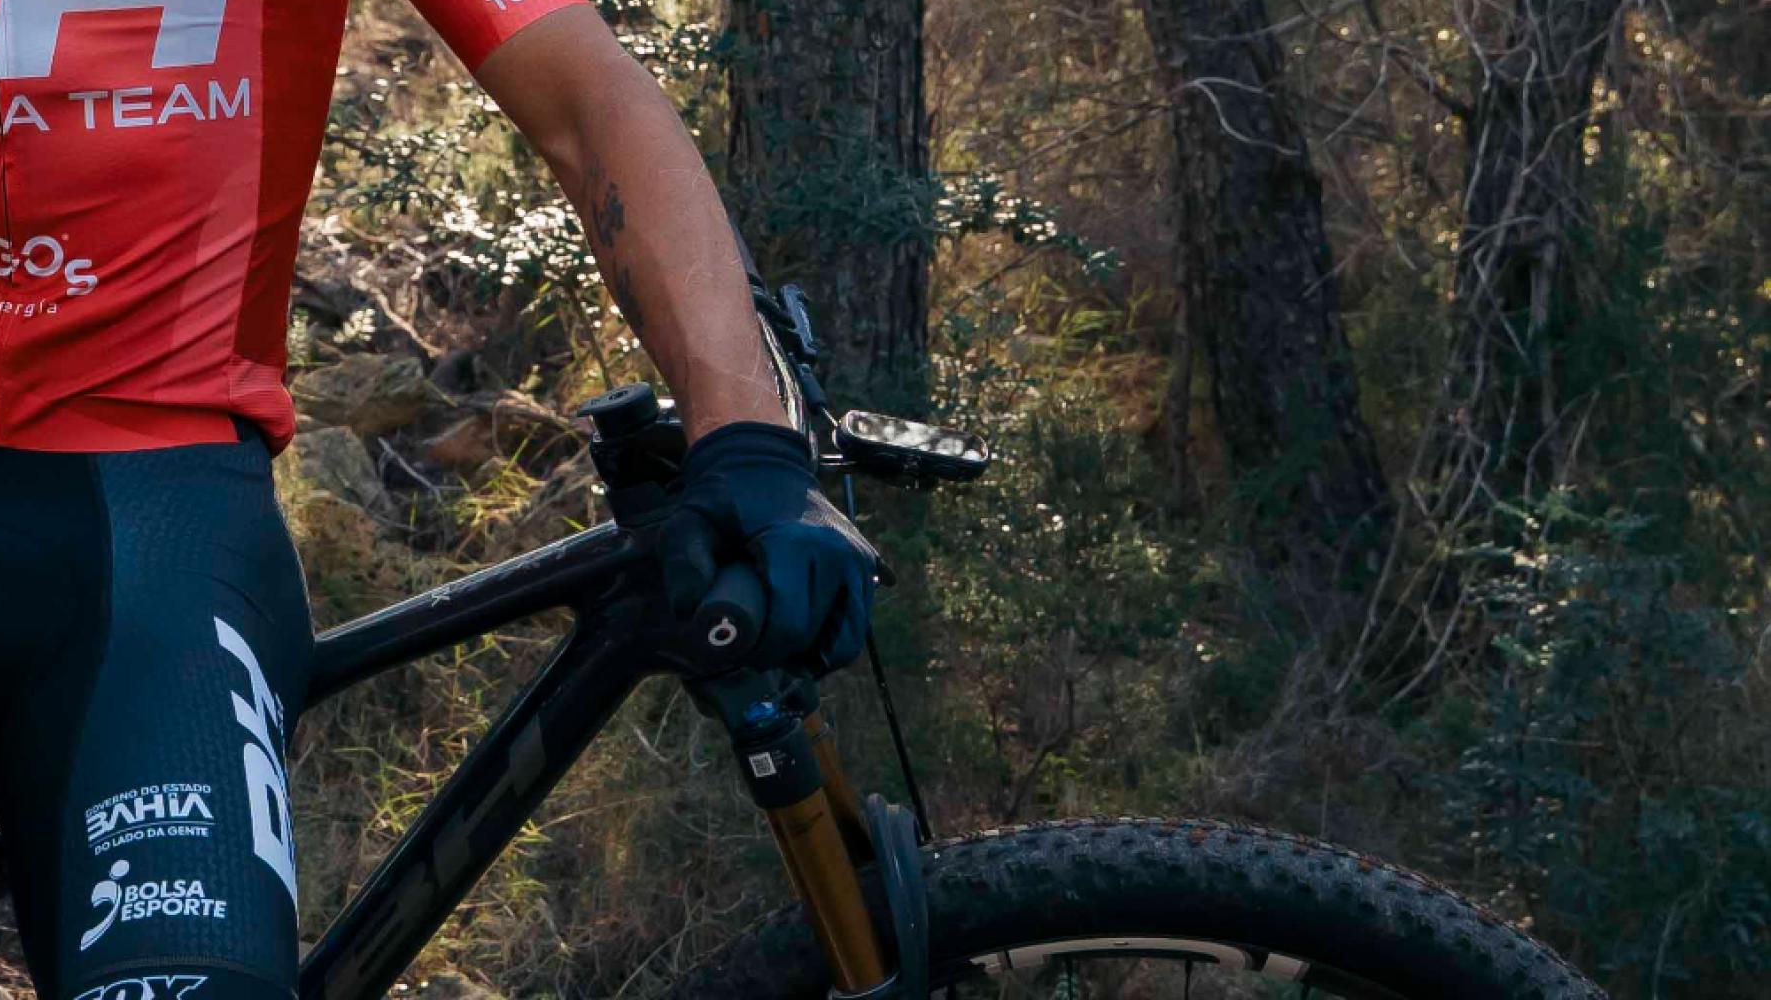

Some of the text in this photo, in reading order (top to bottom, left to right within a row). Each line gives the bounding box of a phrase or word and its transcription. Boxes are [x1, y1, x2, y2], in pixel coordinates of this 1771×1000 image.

[68, 77, 252, 131] TEAM
[140, 784, 160, 797] DO
[162, 783, 212, 795] ESTADO
[112, 828, 145, 848] LADO
[147, 827, 165, 838] DA
[167, 825, 210, 838] GENTE
[125, 880, 206, 905] BOLSA
[121, 898, 227, 923] ESPORTE
